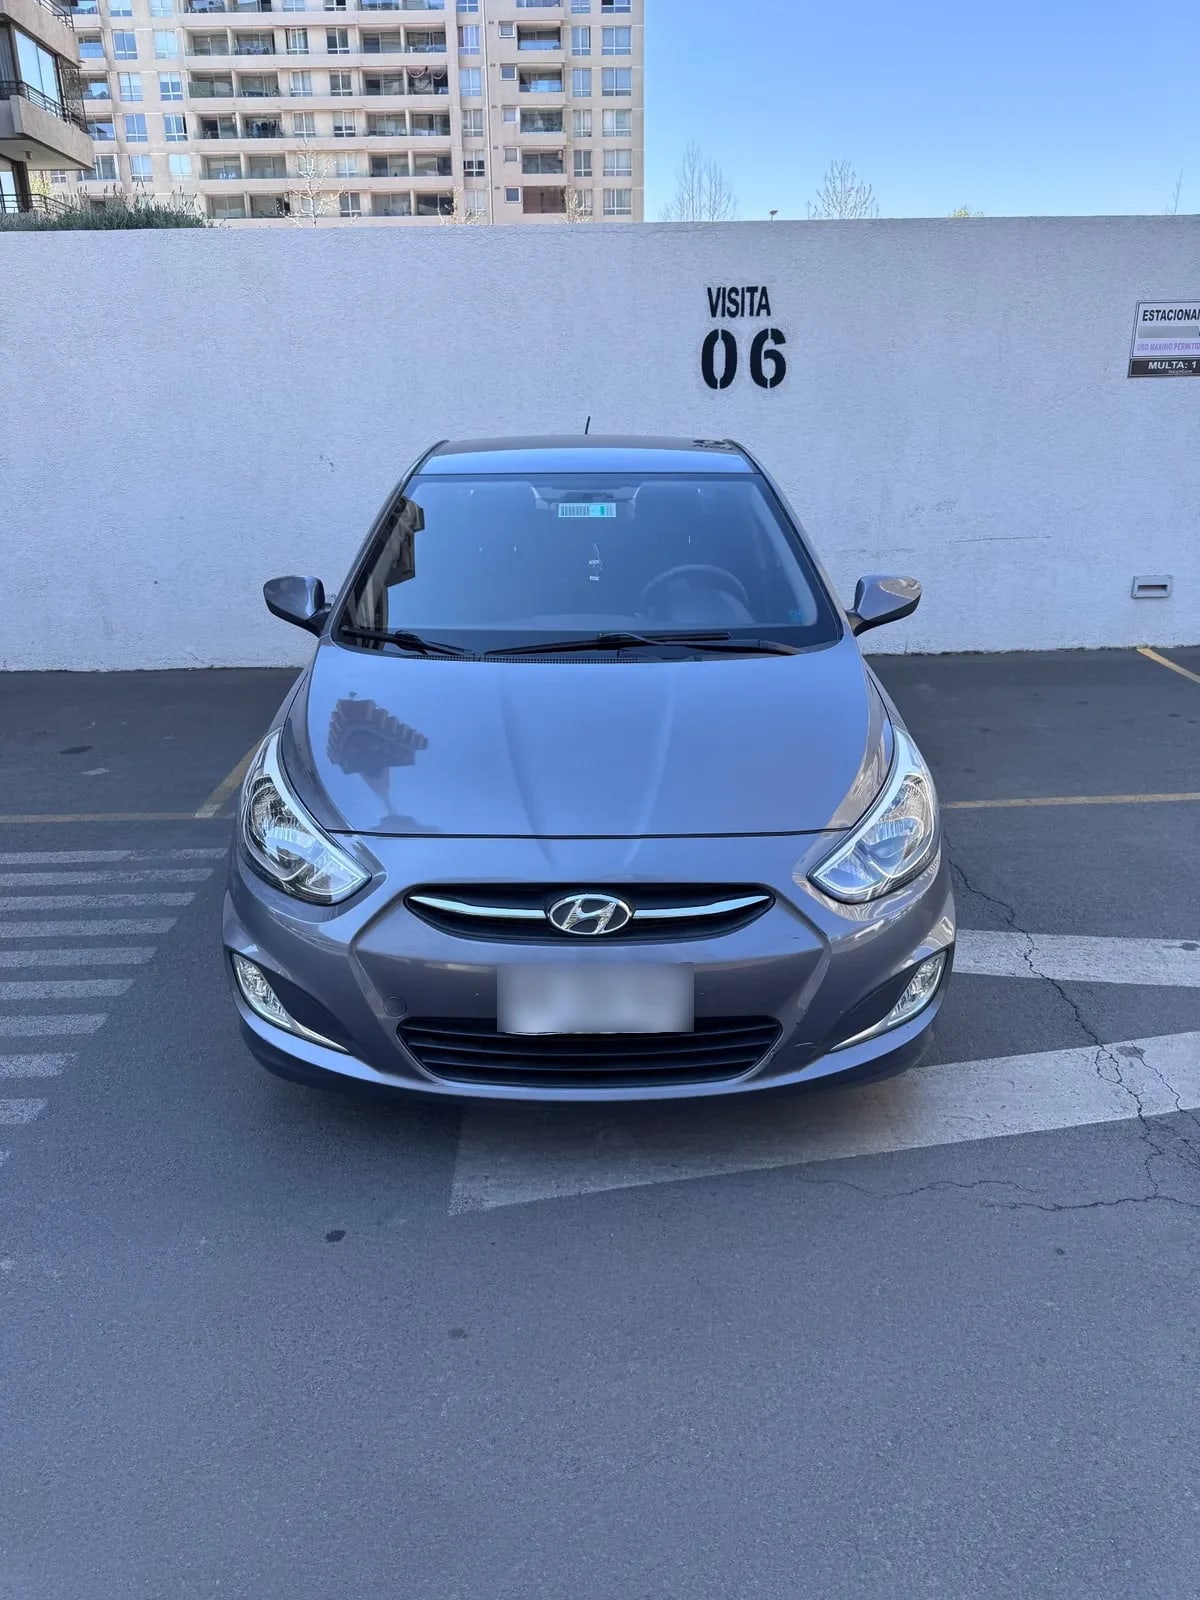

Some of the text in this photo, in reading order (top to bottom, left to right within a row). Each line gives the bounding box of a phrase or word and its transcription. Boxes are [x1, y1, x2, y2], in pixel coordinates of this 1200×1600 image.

[707, 286, 771, 318] VISITA
[701, 328, 786, 389] 06
[1148, 361, 1197, 369] MULTA: 1
